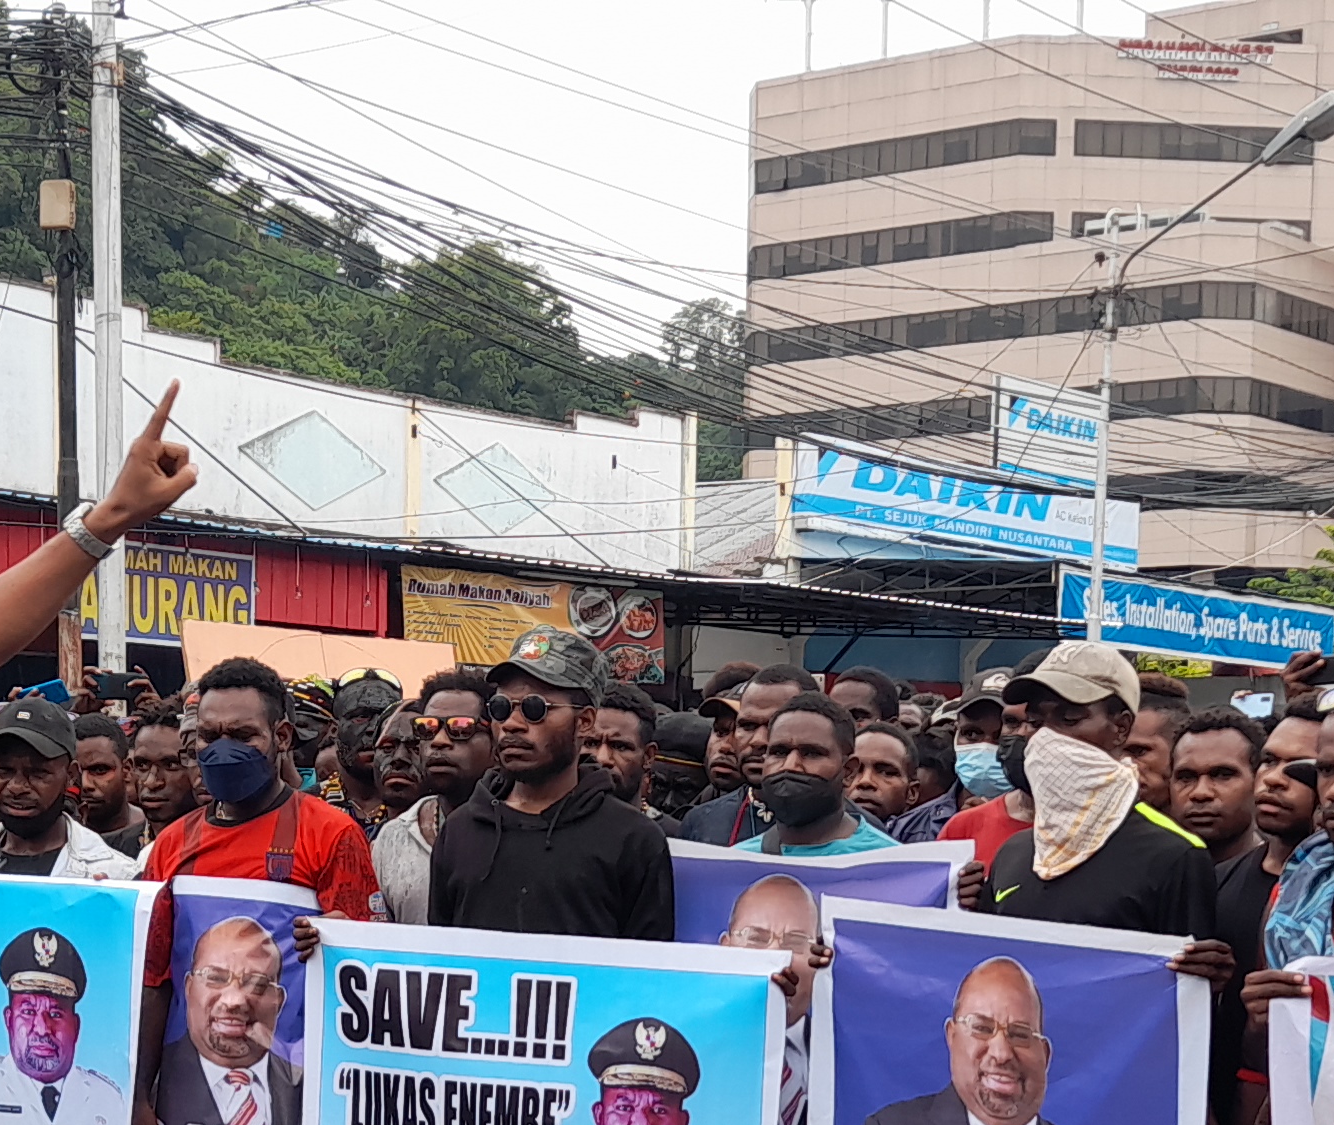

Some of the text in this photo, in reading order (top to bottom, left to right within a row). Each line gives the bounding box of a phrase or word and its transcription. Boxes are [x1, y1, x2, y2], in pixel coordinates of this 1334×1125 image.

[1027, 407, 1098, 442] DAIKIN
[852, 456, 1053, 522] DAIKIN
[883, 510, 927, 527] SEJUK
[934, 517, 992, 538] MANDIRI
[998, 528, 1074, 552] NUSANTARA
[169, 552, 237, 581] MAKAN
[408, 578, 455, 597] Rumah
[458, 582, 501, 602] Makan
[80, 571, 248, 636] AURANG
[1083, 587, 1322, 651] Sles, Installation, Spare Parts & Service
[339, 964, 572, 1060] SAVE...!!!
